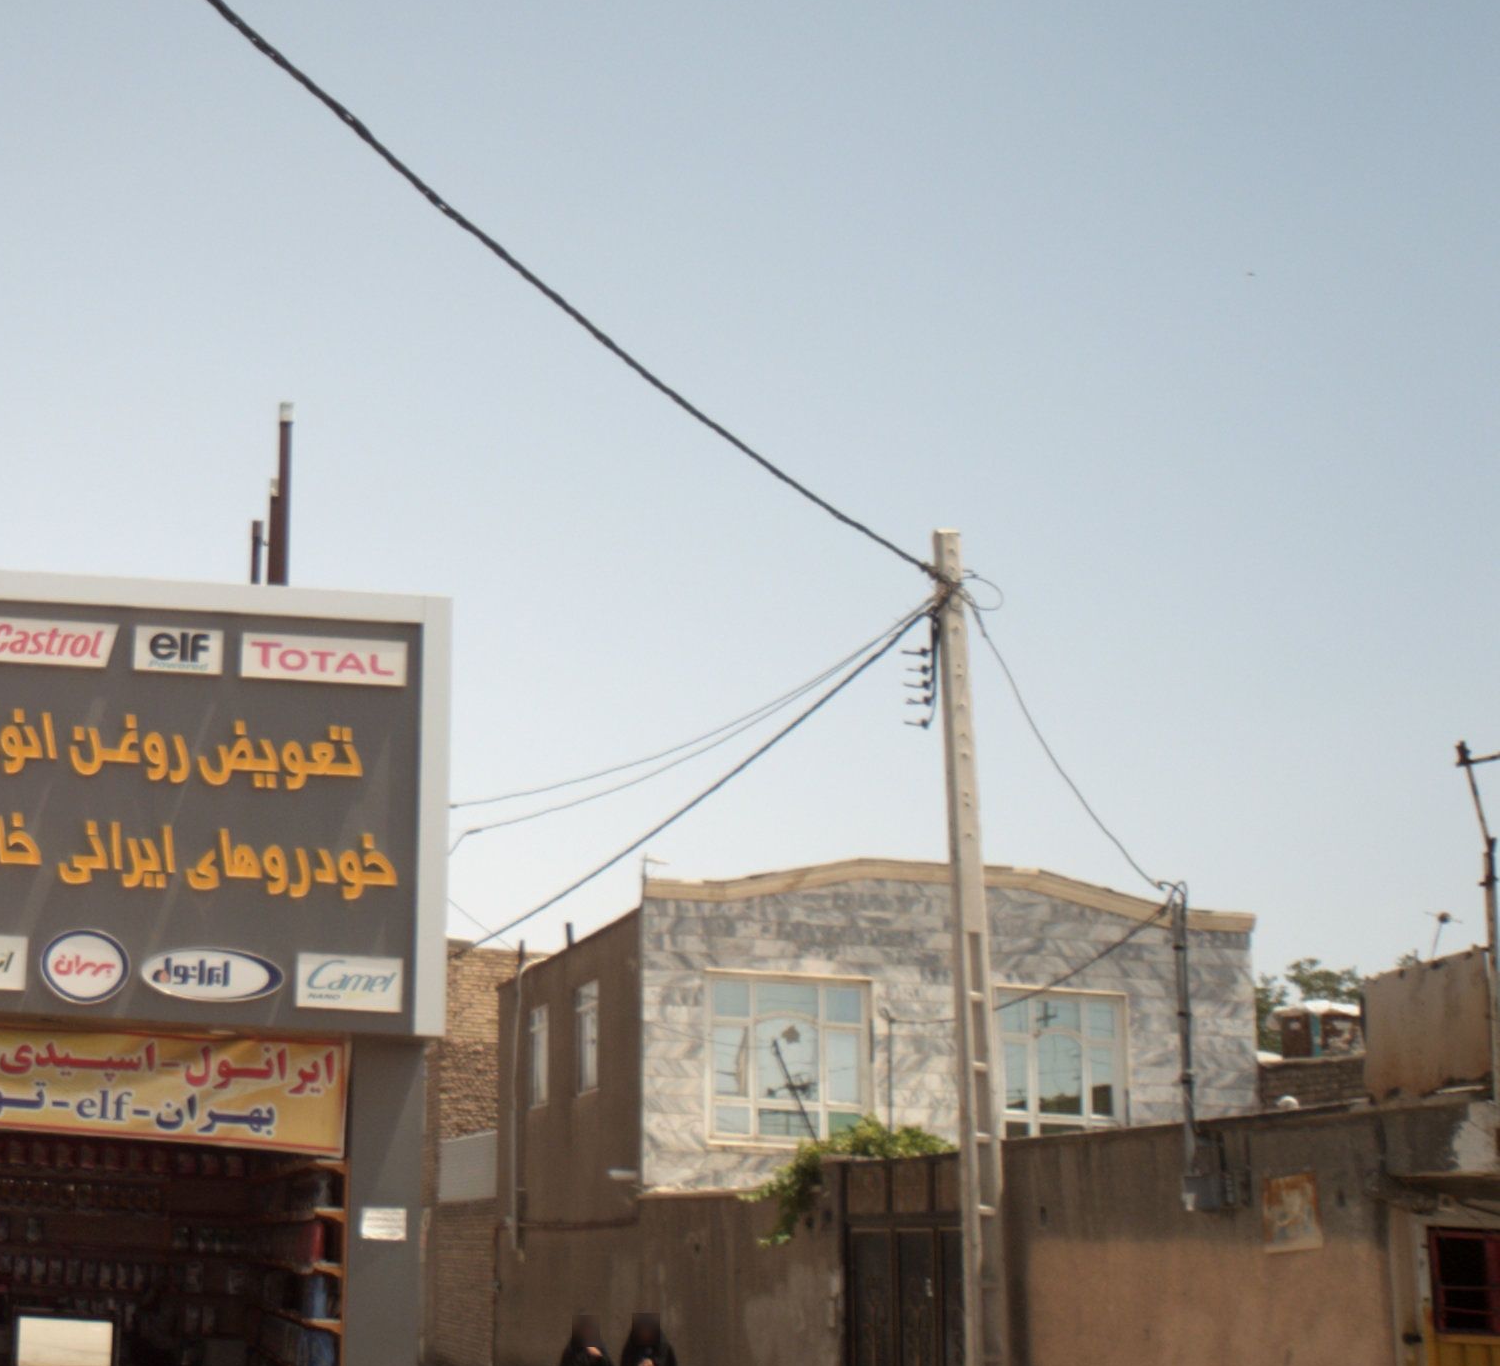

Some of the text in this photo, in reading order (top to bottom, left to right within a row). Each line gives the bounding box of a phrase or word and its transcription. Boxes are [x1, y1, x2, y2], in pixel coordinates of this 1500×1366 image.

[148, 631, 211, 663] elf
[68, 713, 192, 784] روغن
[197, 720, 364, 790] تعویض
[58, 820, 178, 889] ایرانی
[186, 827, 399, 900] خودروهای
[306, 958, 397, 993] Camel
[0, 1039, 156, 1083] اسپیدی
[184, 1045, 337, 1095] ایرانول
[76, 1089, 132, 1122] elf
[155, 1092, 278, 1137] بهران
